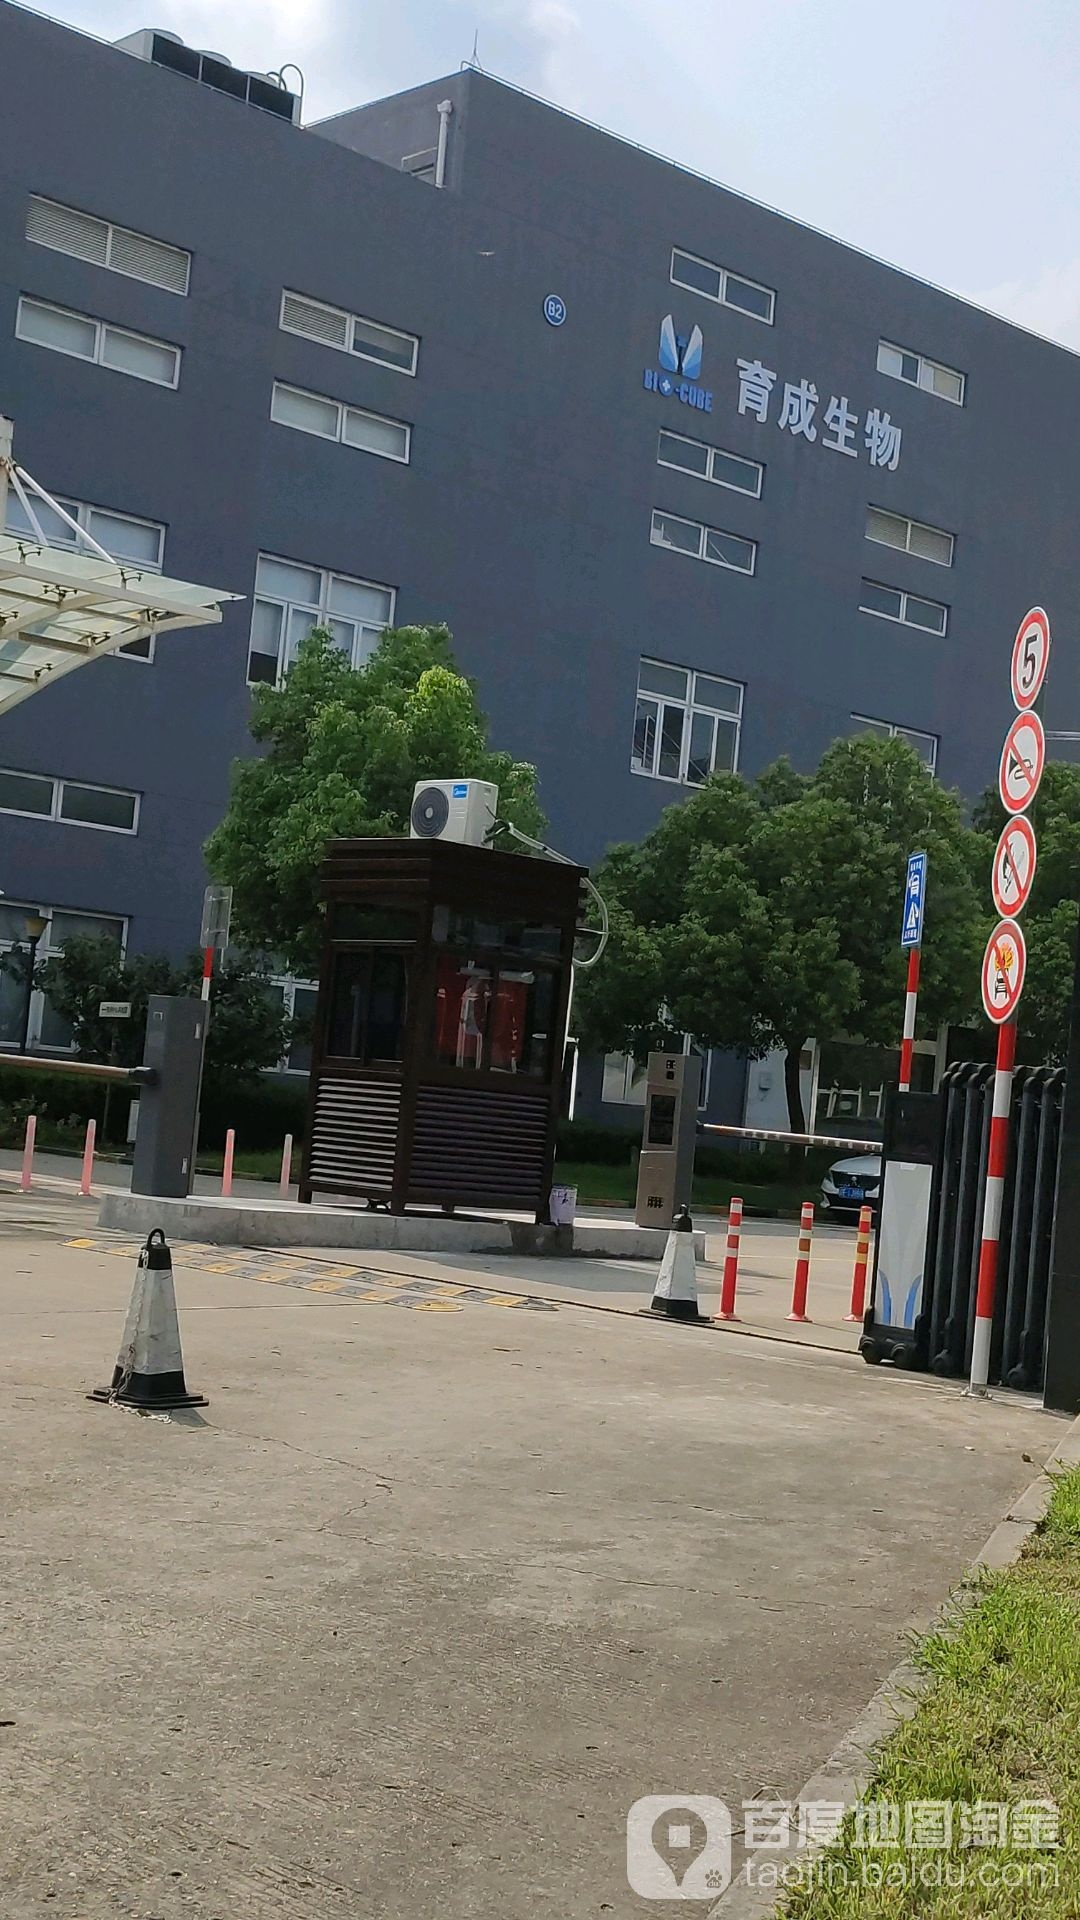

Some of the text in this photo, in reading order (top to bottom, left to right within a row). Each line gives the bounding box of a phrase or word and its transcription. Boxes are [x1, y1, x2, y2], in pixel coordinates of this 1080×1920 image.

[549, 300, 562, 319] B2
[736, 357, 902, 471] 育成生物
[1022, 633, 1038, 689] 5
